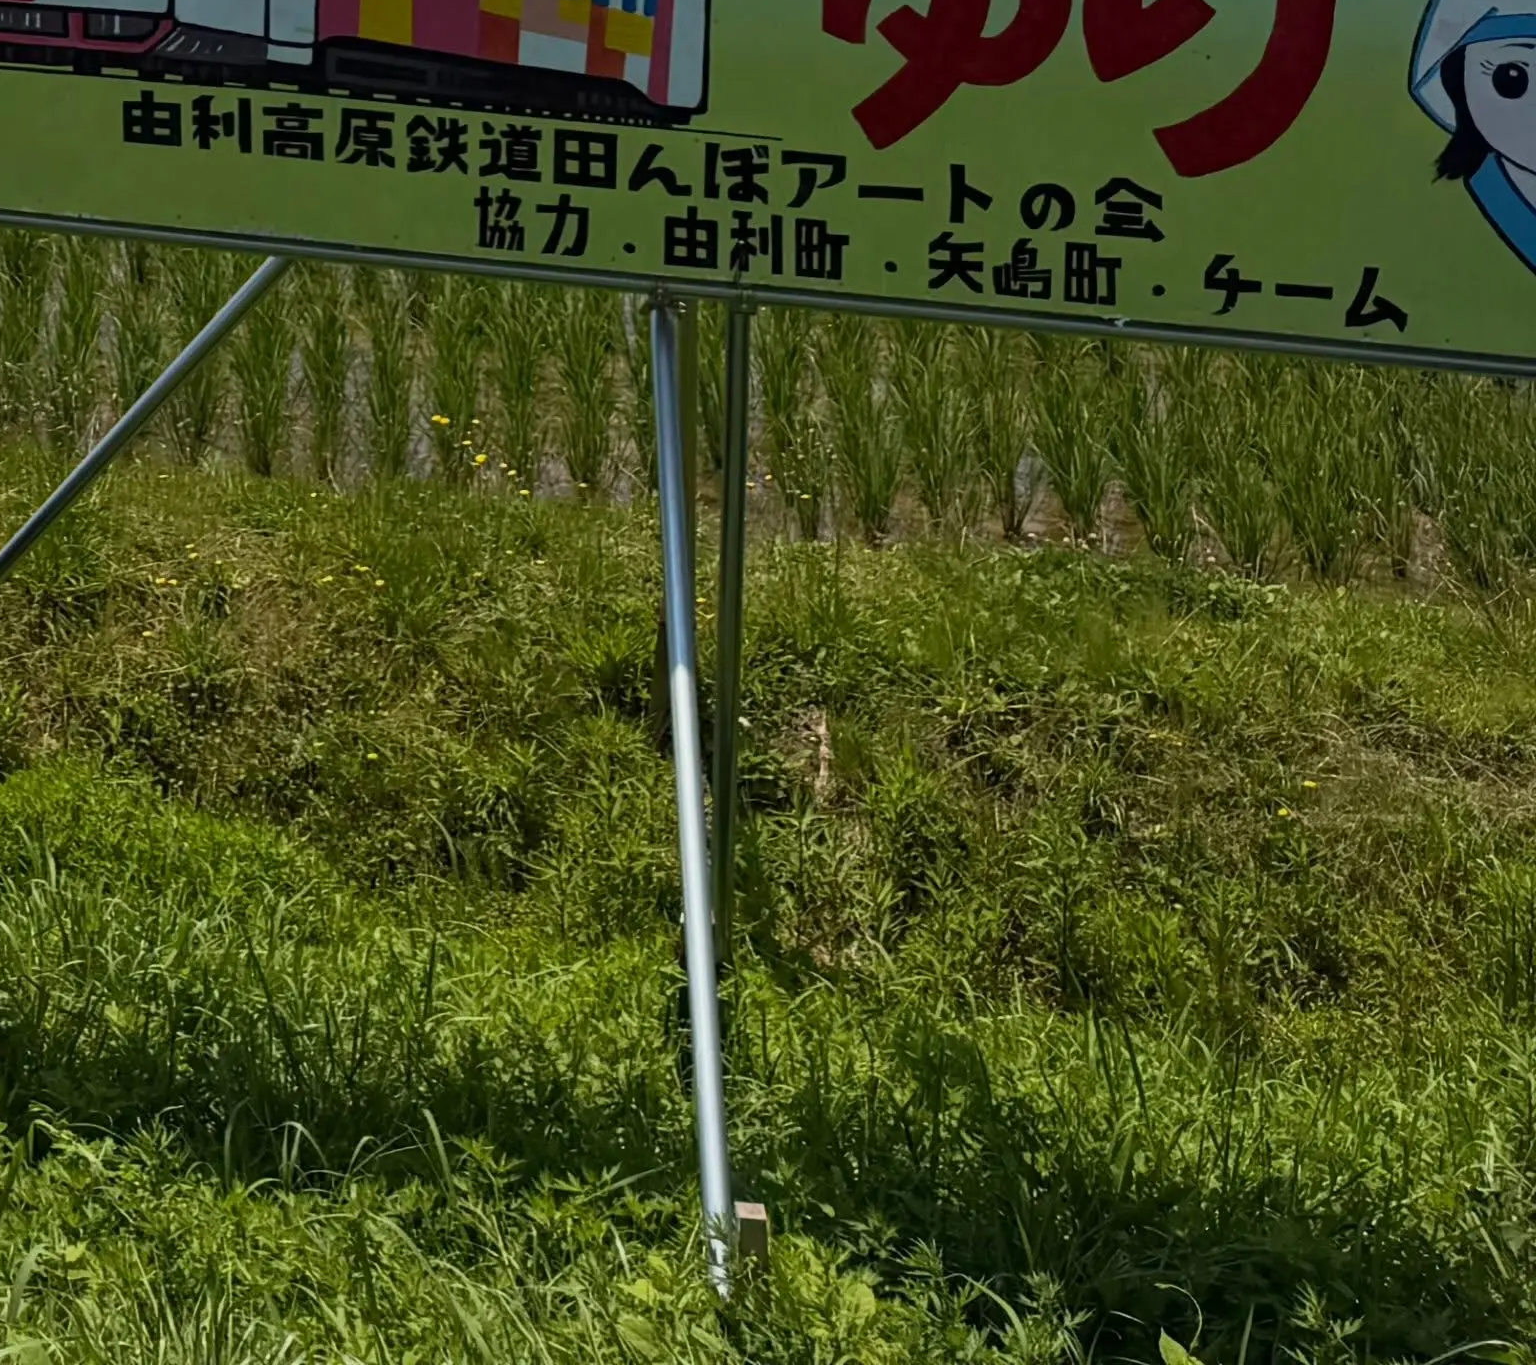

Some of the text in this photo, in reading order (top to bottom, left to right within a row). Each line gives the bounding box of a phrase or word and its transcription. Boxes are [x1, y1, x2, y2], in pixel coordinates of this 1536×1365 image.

[122, 90, 1166, 243] 由利高原鉄道田んぼアートの会
